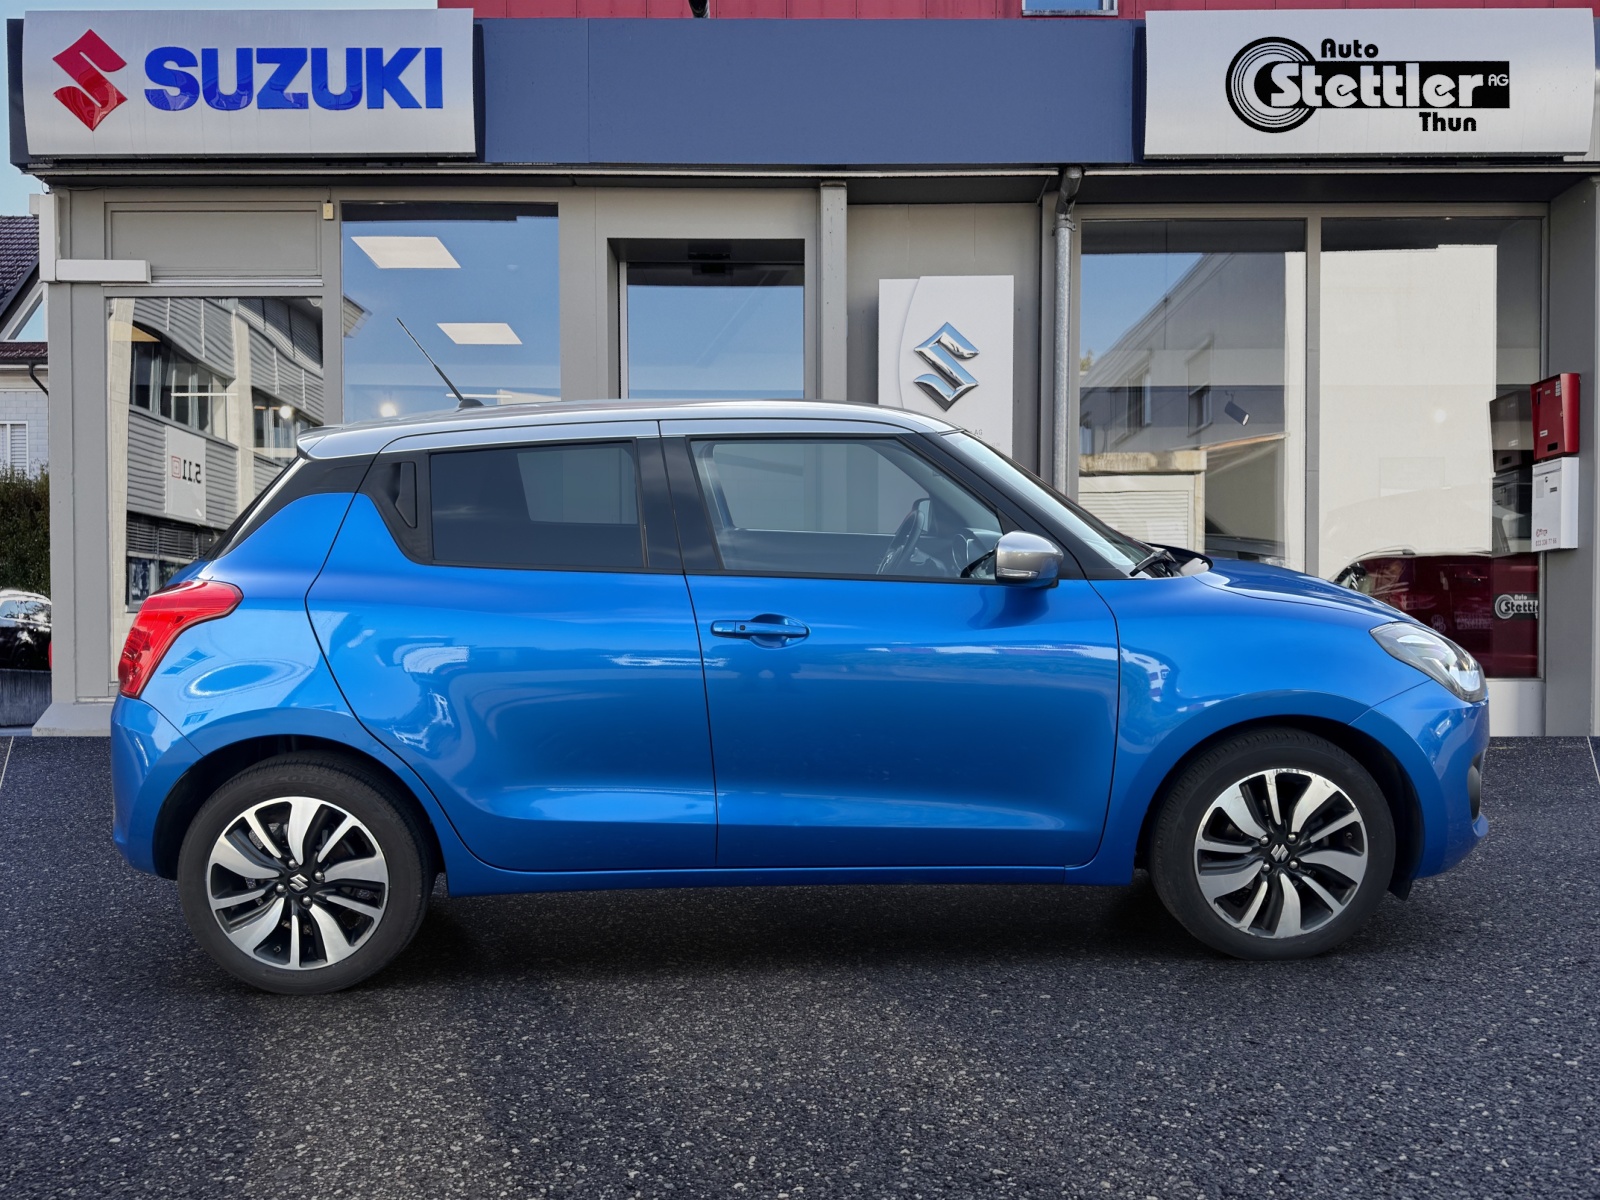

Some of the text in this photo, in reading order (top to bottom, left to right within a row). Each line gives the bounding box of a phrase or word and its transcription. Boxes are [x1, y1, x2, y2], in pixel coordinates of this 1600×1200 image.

[1320, 38, 1379, 59] Auto
[144, 46, 443, 111] SUZUKI
[1270, 62, 1509, 108] Stettler AG
[1419, 111, 1477, 132] Thun
